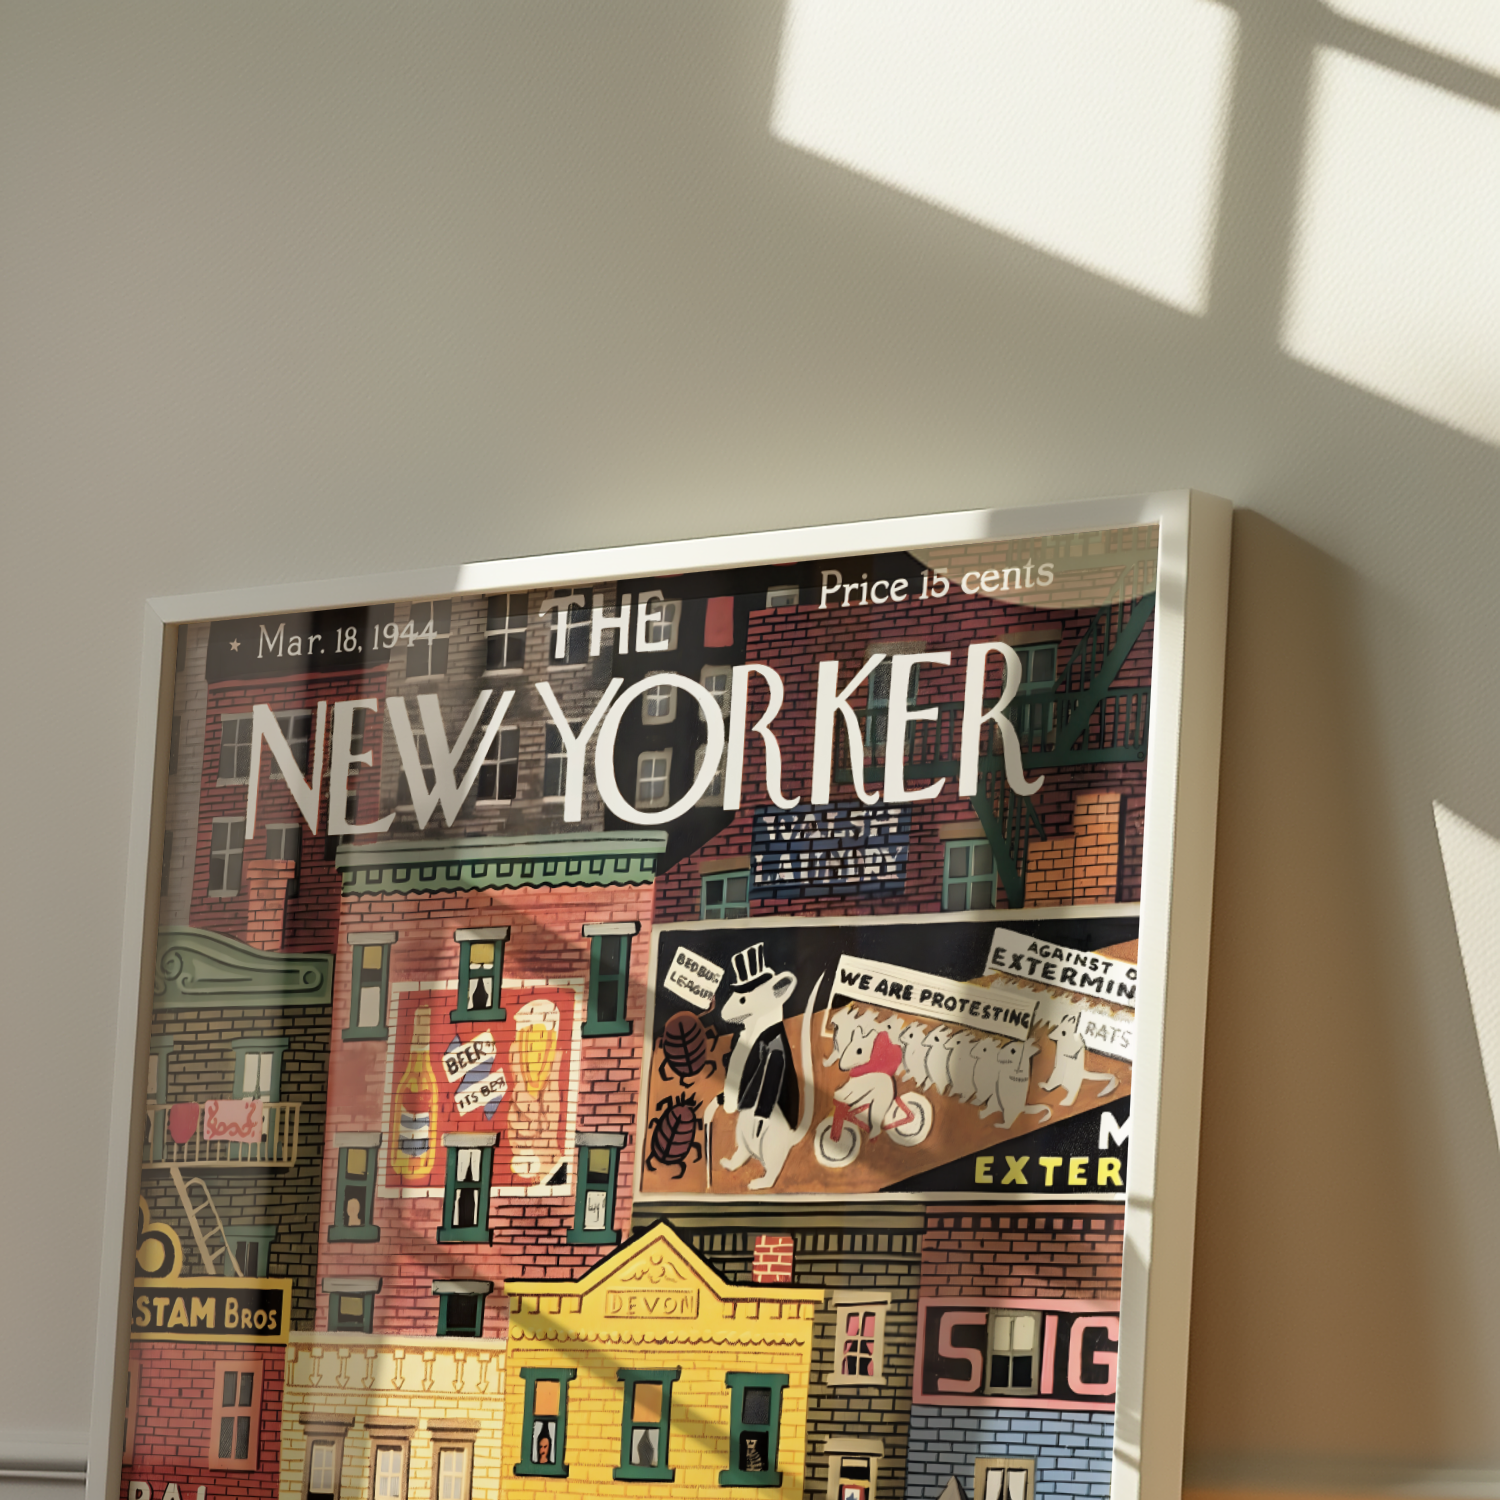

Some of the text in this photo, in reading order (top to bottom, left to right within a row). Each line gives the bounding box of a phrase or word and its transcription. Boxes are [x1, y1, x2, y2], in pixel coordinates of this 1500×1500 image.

[818, 559, 1056, 609] Price 15 cents
[256, 619, 438, 659] Mar. 18, 1944
[538, 590, 670, 659] THE
[244, 641, 1046, 840] NEW YORKER
[991, 946, 1137, 1000] EXTERMIN
[1027, 941, 1114, 975] AGAINST
[840, 968, 1032, 1030] WE ARE PROTESTING
[1084, 1020, 1133, 1049] RATS
[445, 1041, 487, 1076] BEER
[460, 1091, 479, 1109] ITS
[974, 1155, 1124, 1187] EXTER
[131, 1296, 216, 1329] STAM
[611, 1295, 694, 1316] DEVON
